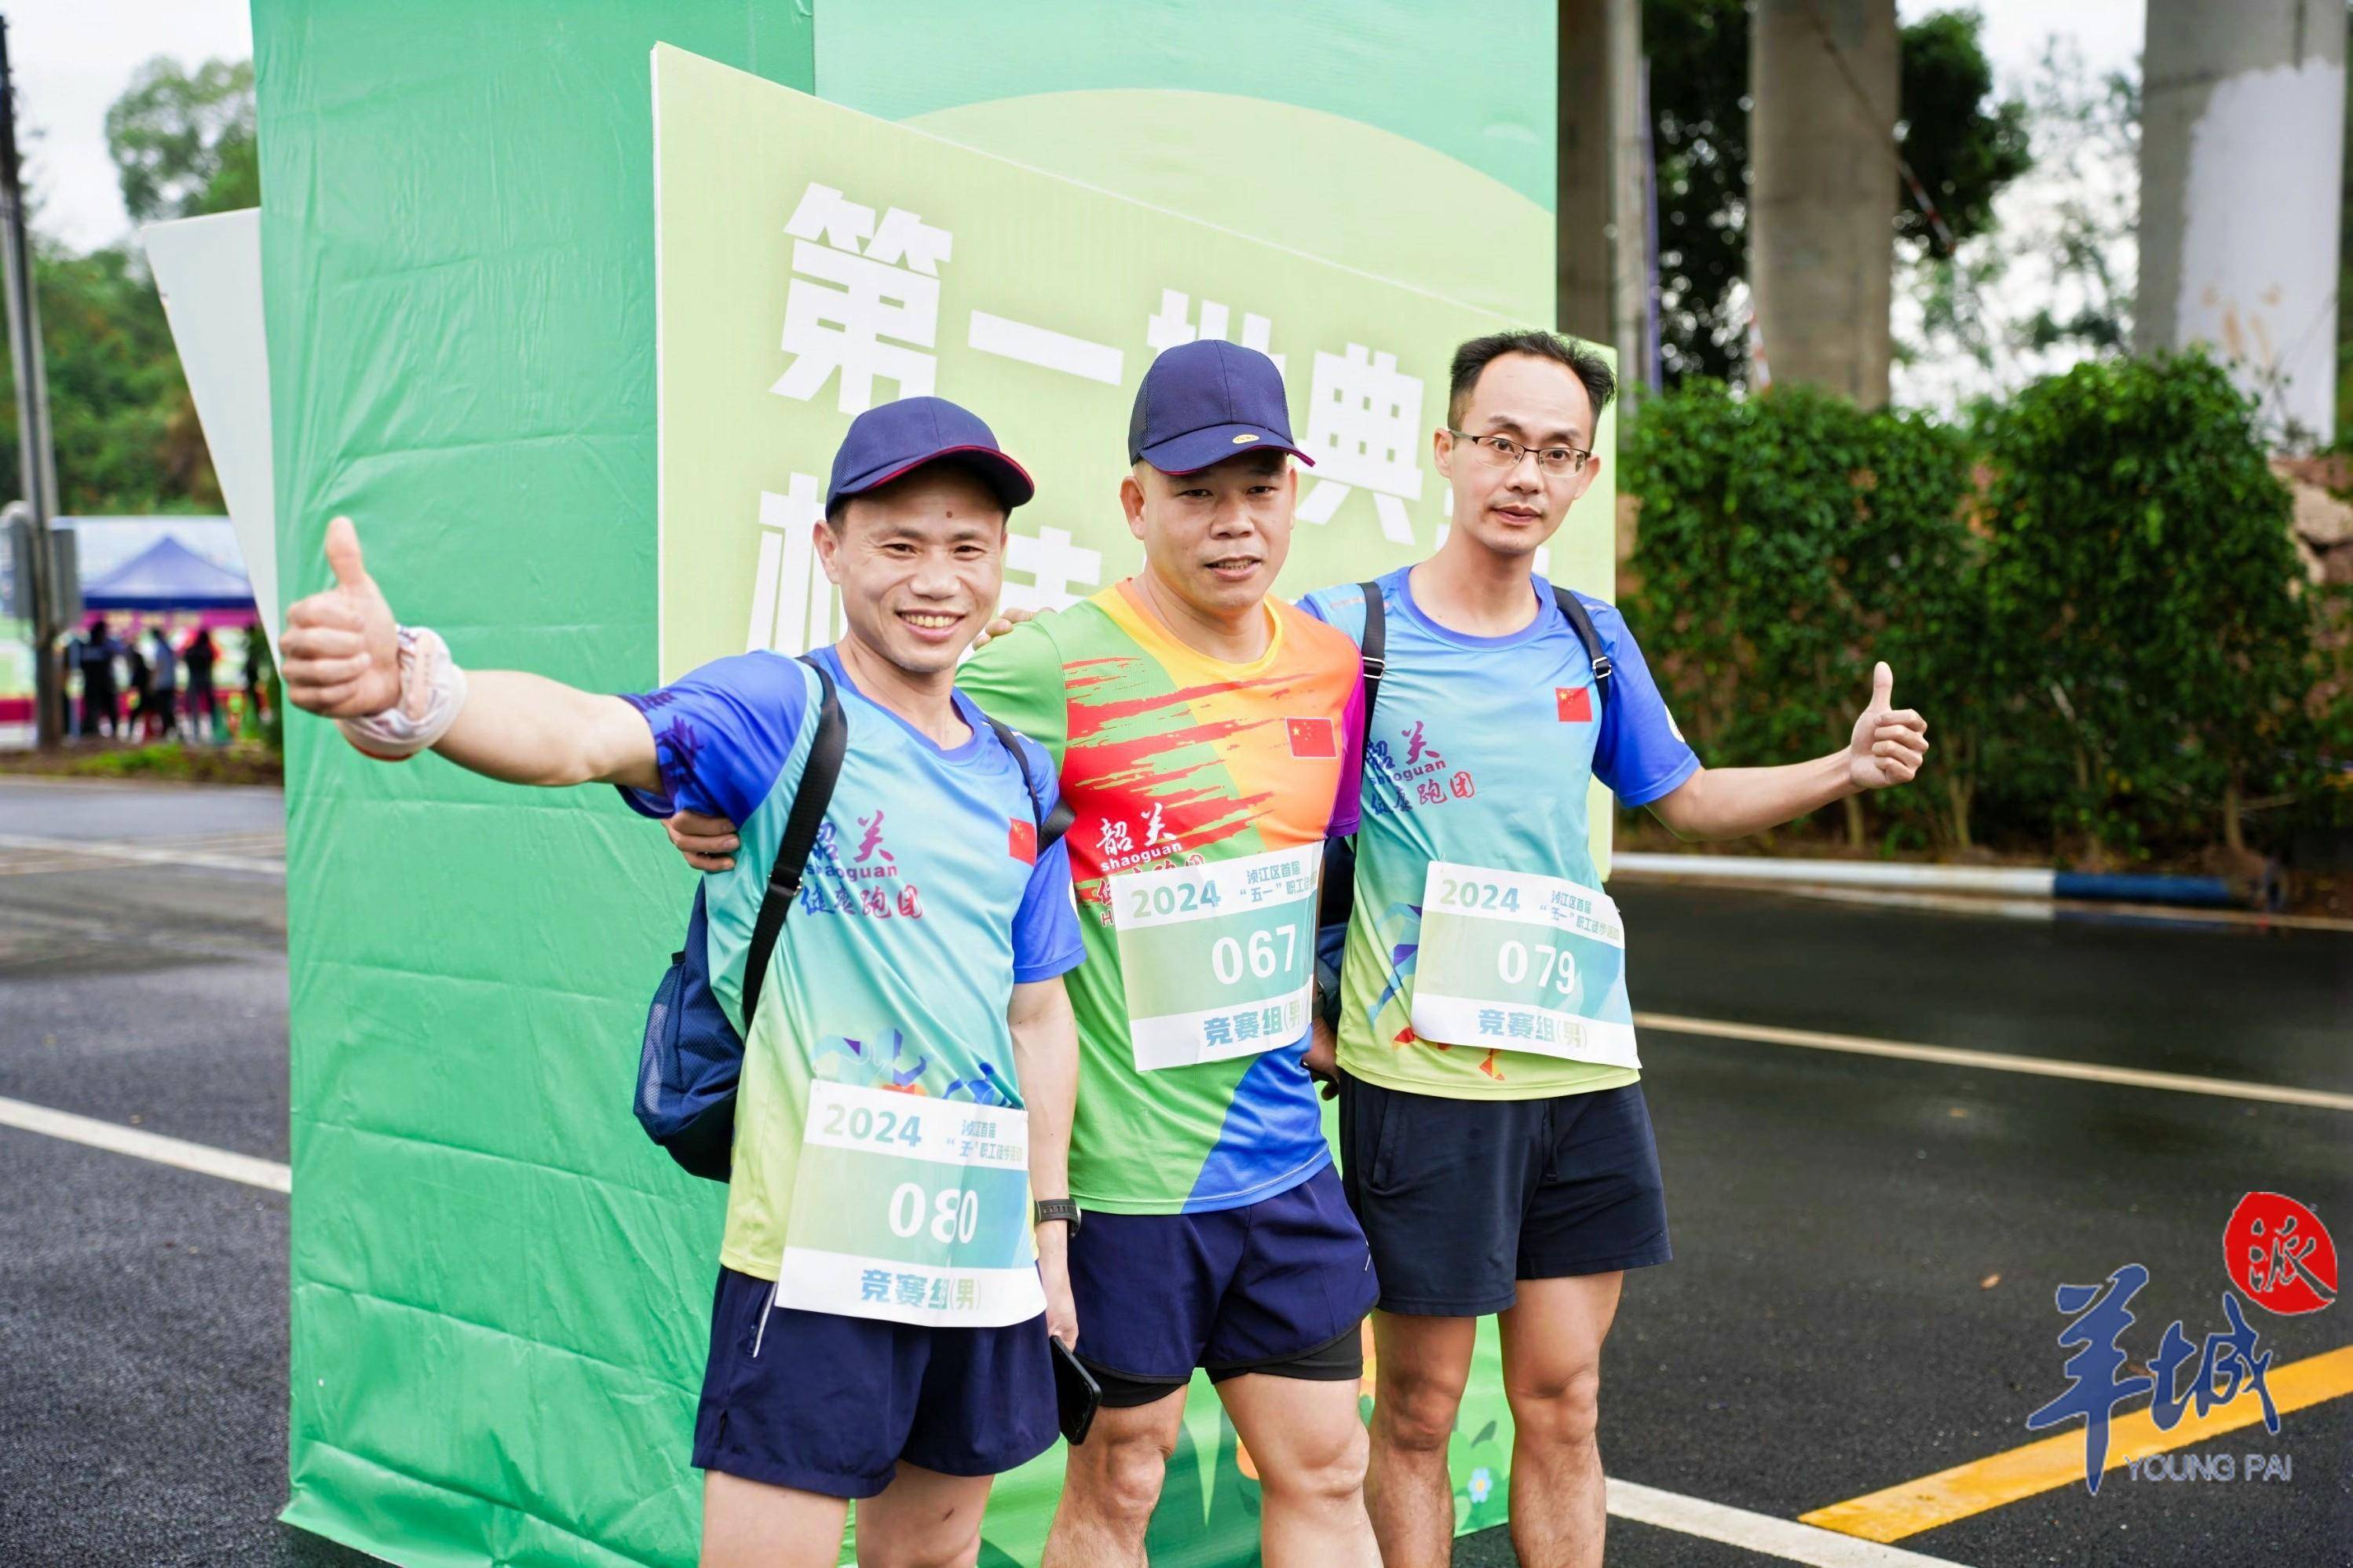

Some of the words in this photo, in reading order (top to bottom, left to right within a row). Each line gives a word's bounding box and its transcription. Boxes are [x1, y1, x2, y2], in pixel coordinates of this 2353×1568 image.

[1096, 802, 1178, 856] 韶关
[1101, 842, 1182, 872] shaoguan
[1131, 879, 1222, 919] 2024
[1439, 879, 1521, 913] 2024
[1211, 923, 1297, 985] 067
[1497, 940, 1577, 995] 079
[822, 1103, 923, 1148] 2024
[888, 1182, 980, 1245] 080
